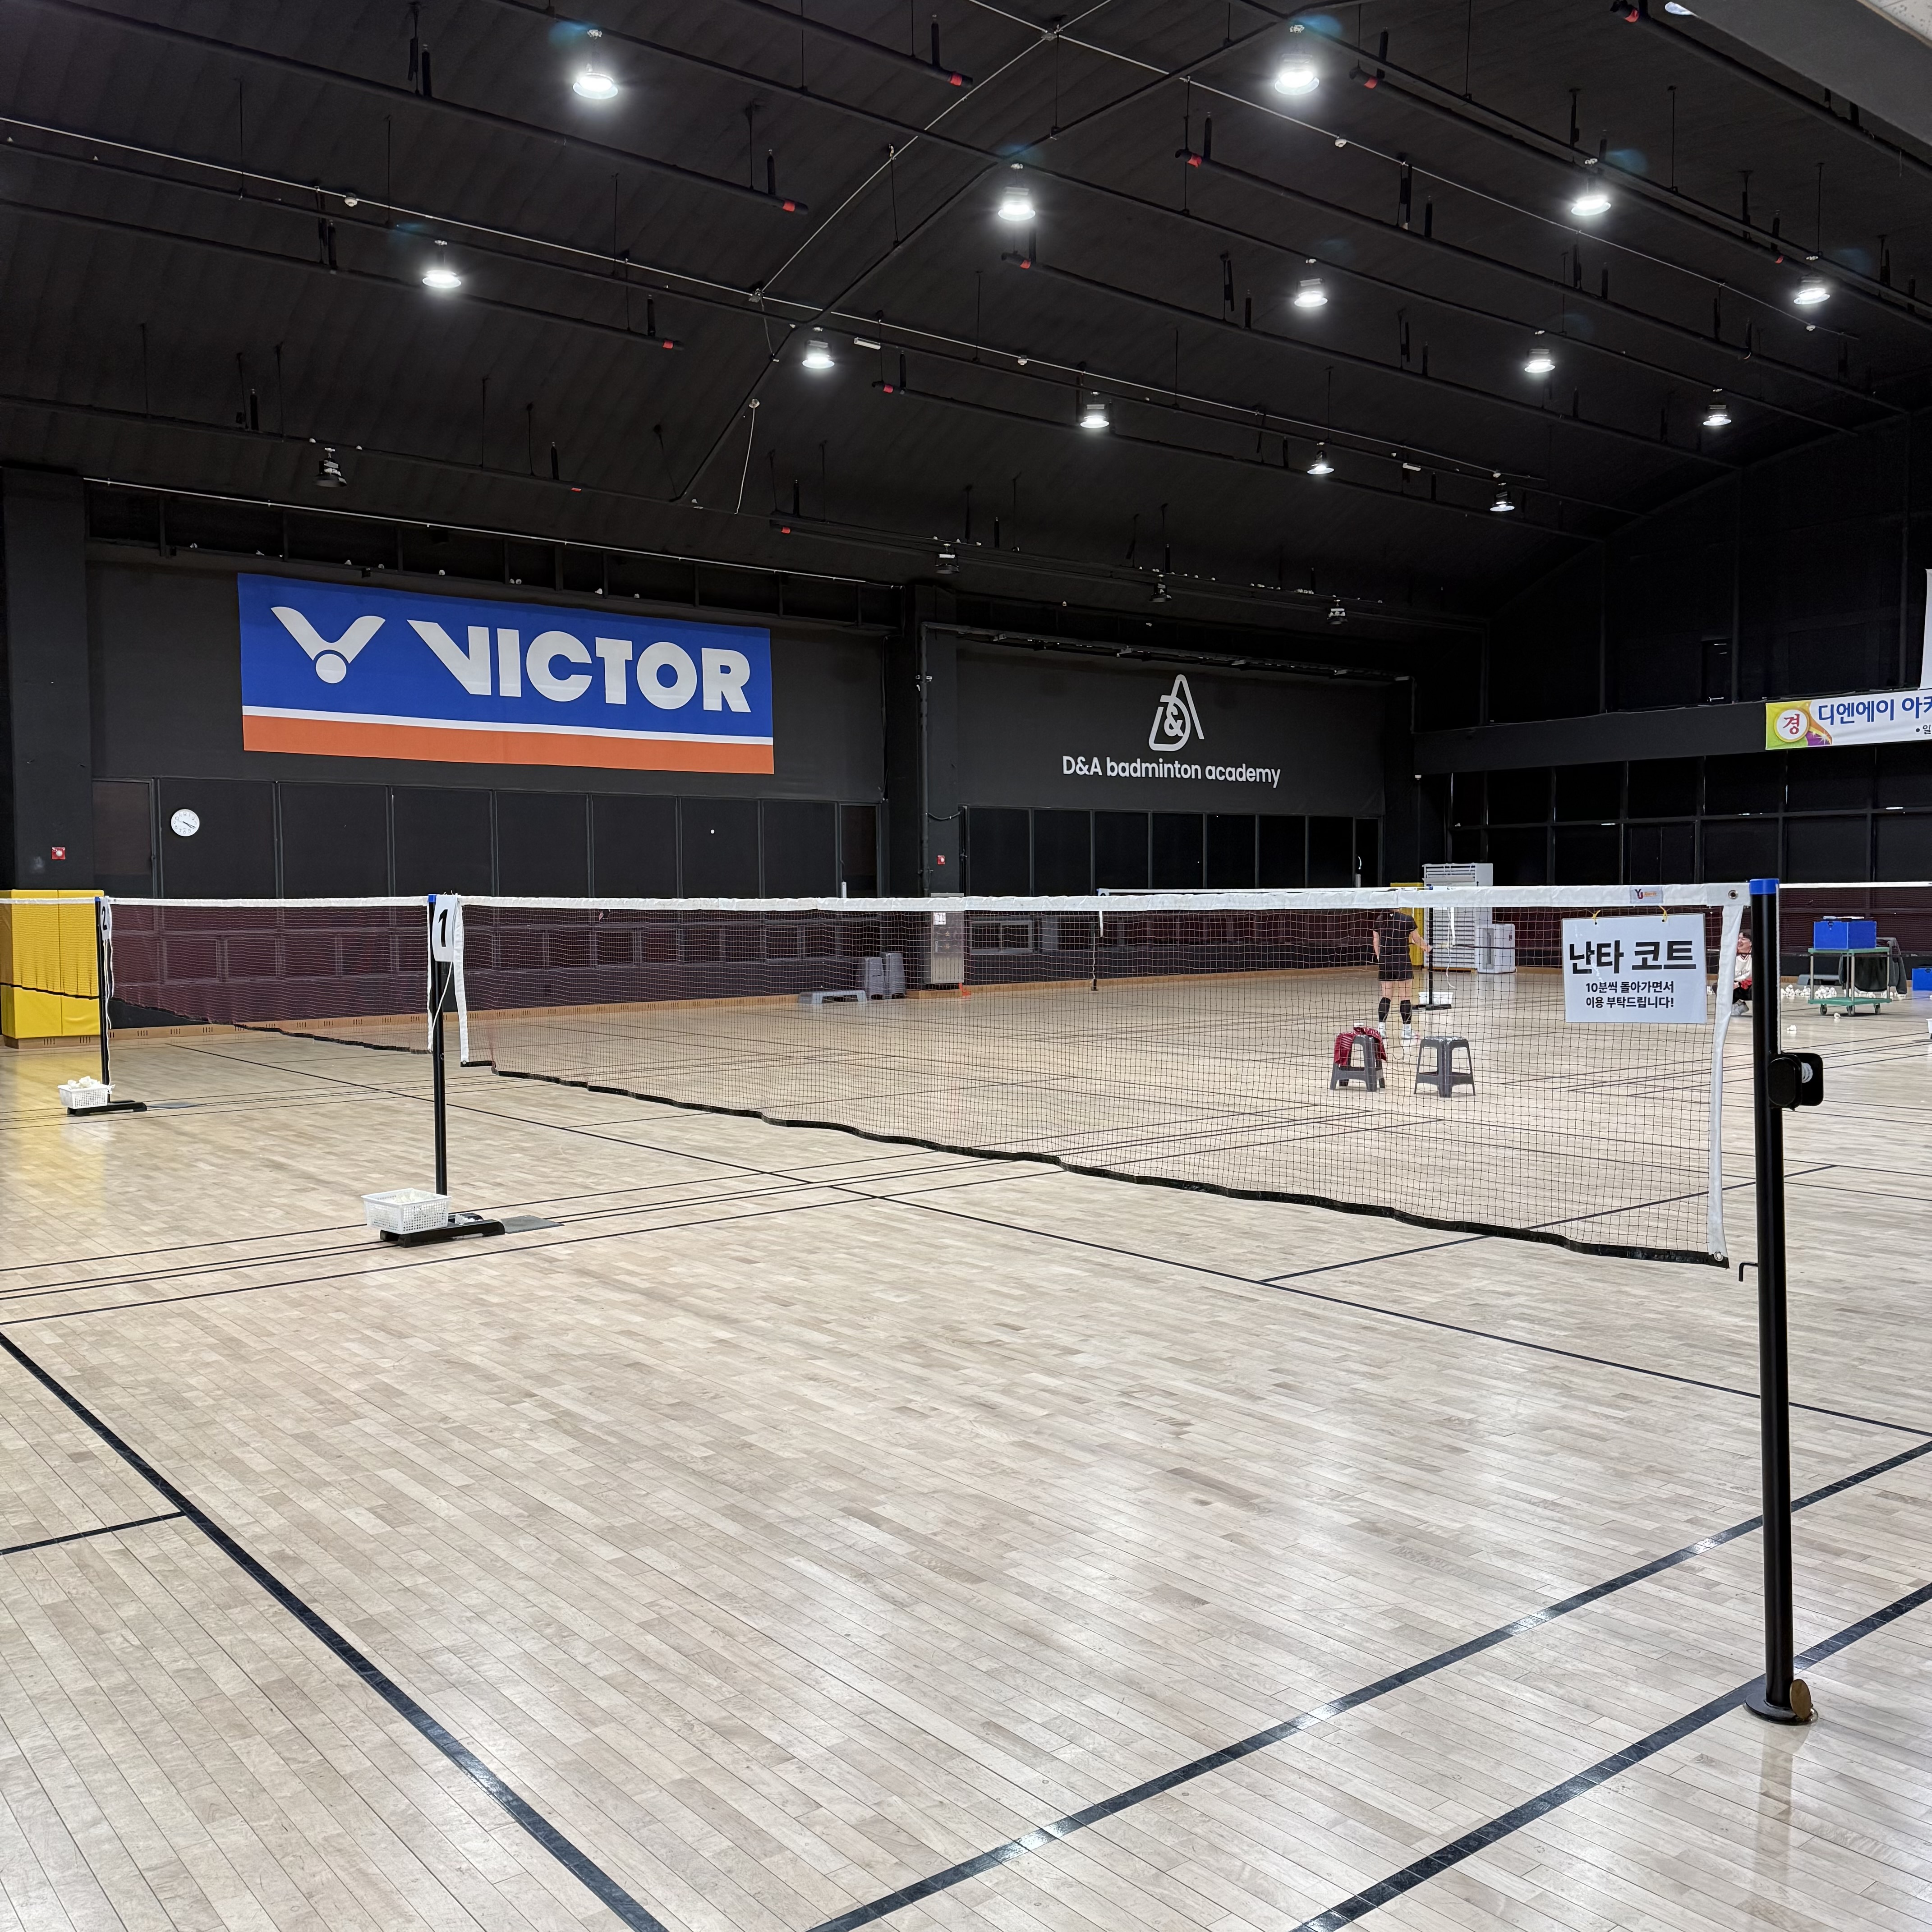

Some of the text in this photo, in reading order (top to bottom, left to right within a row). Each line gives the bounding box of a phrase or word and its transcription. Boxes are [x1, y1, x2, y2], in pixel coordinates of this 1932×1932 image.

[407, 620, 751, 713] VICTOR
[1783, 713, 1800, 735] 경
[1818, 699, 1895, 726] 디엔에이
[1062, 755, 1281, 789] D&A badminton academy
[101, 906, 108, 931] 2
[438, 909, 448, 948] 1
[1569, 940, 1697, 974] 난타 코트
[1586, 981, 1674, 993] 10분씩 돌아가면서
[1586, 996, 1674, 1008] 이용 부탁드립니다!
